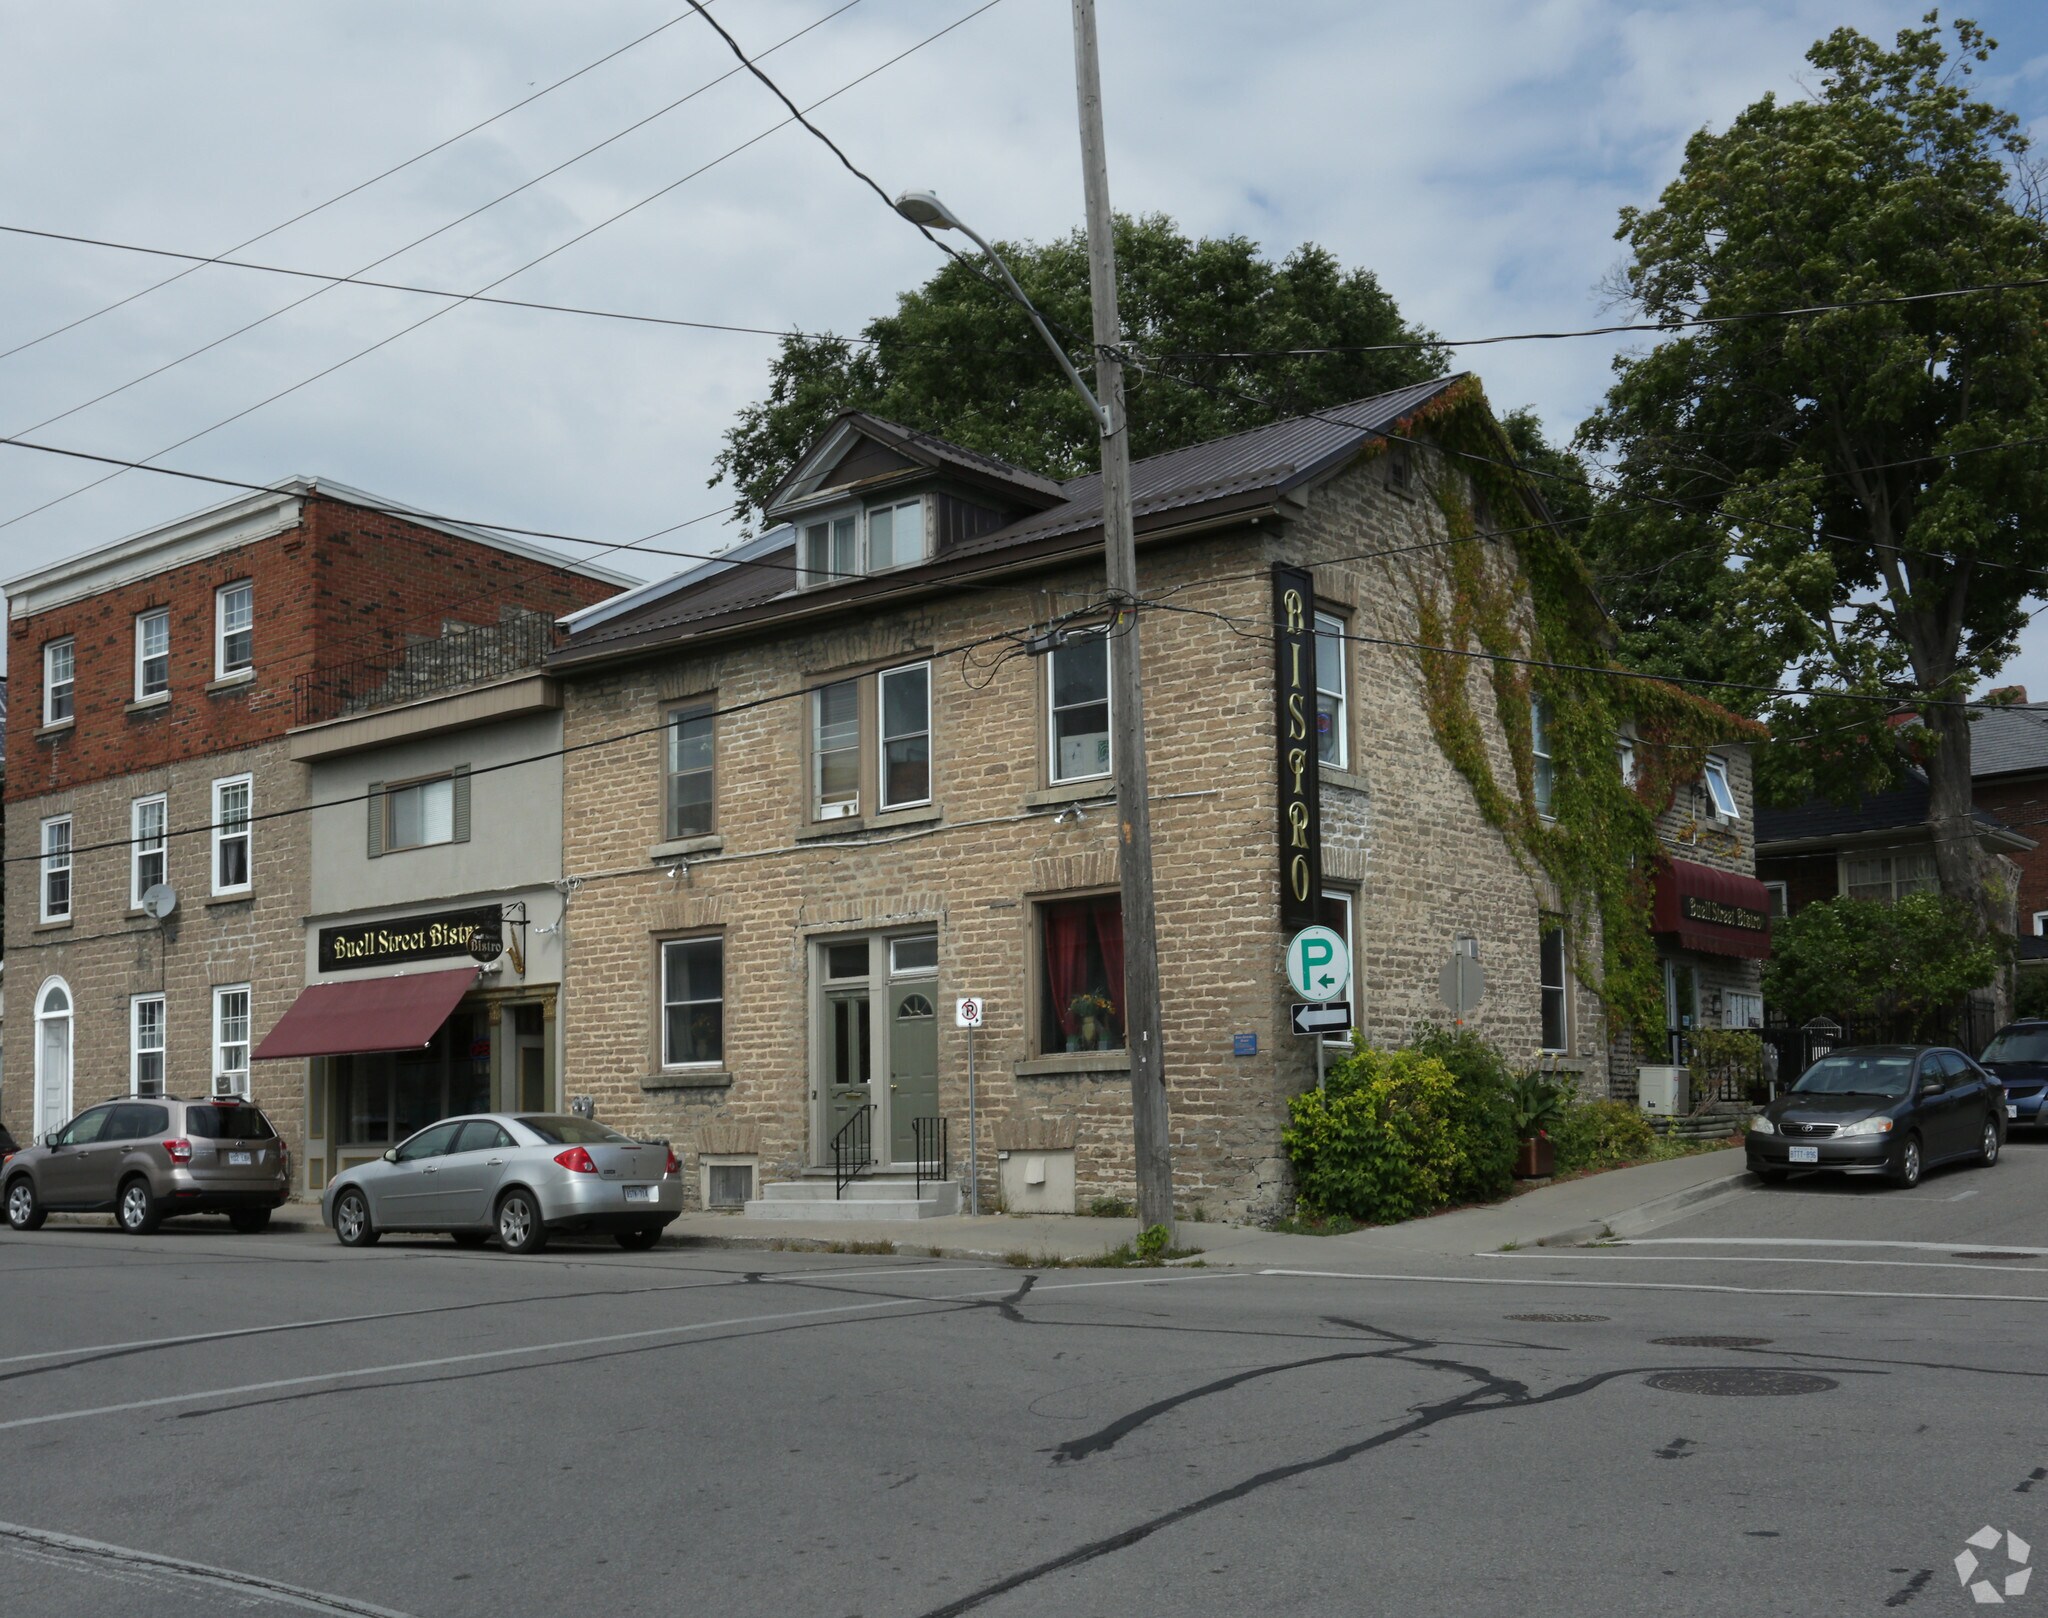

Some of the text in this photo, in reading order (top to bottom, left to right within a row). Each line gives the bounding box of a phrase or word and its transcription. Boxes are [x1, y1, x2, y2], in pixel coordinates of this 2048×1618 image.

[1284, 588, 1310, 902] BISTRO
[334, 922, 480, 959] Buell Street Bistr
[471, 938, 501, 952] Bistro
[1301, 938, 1333, 990] P
